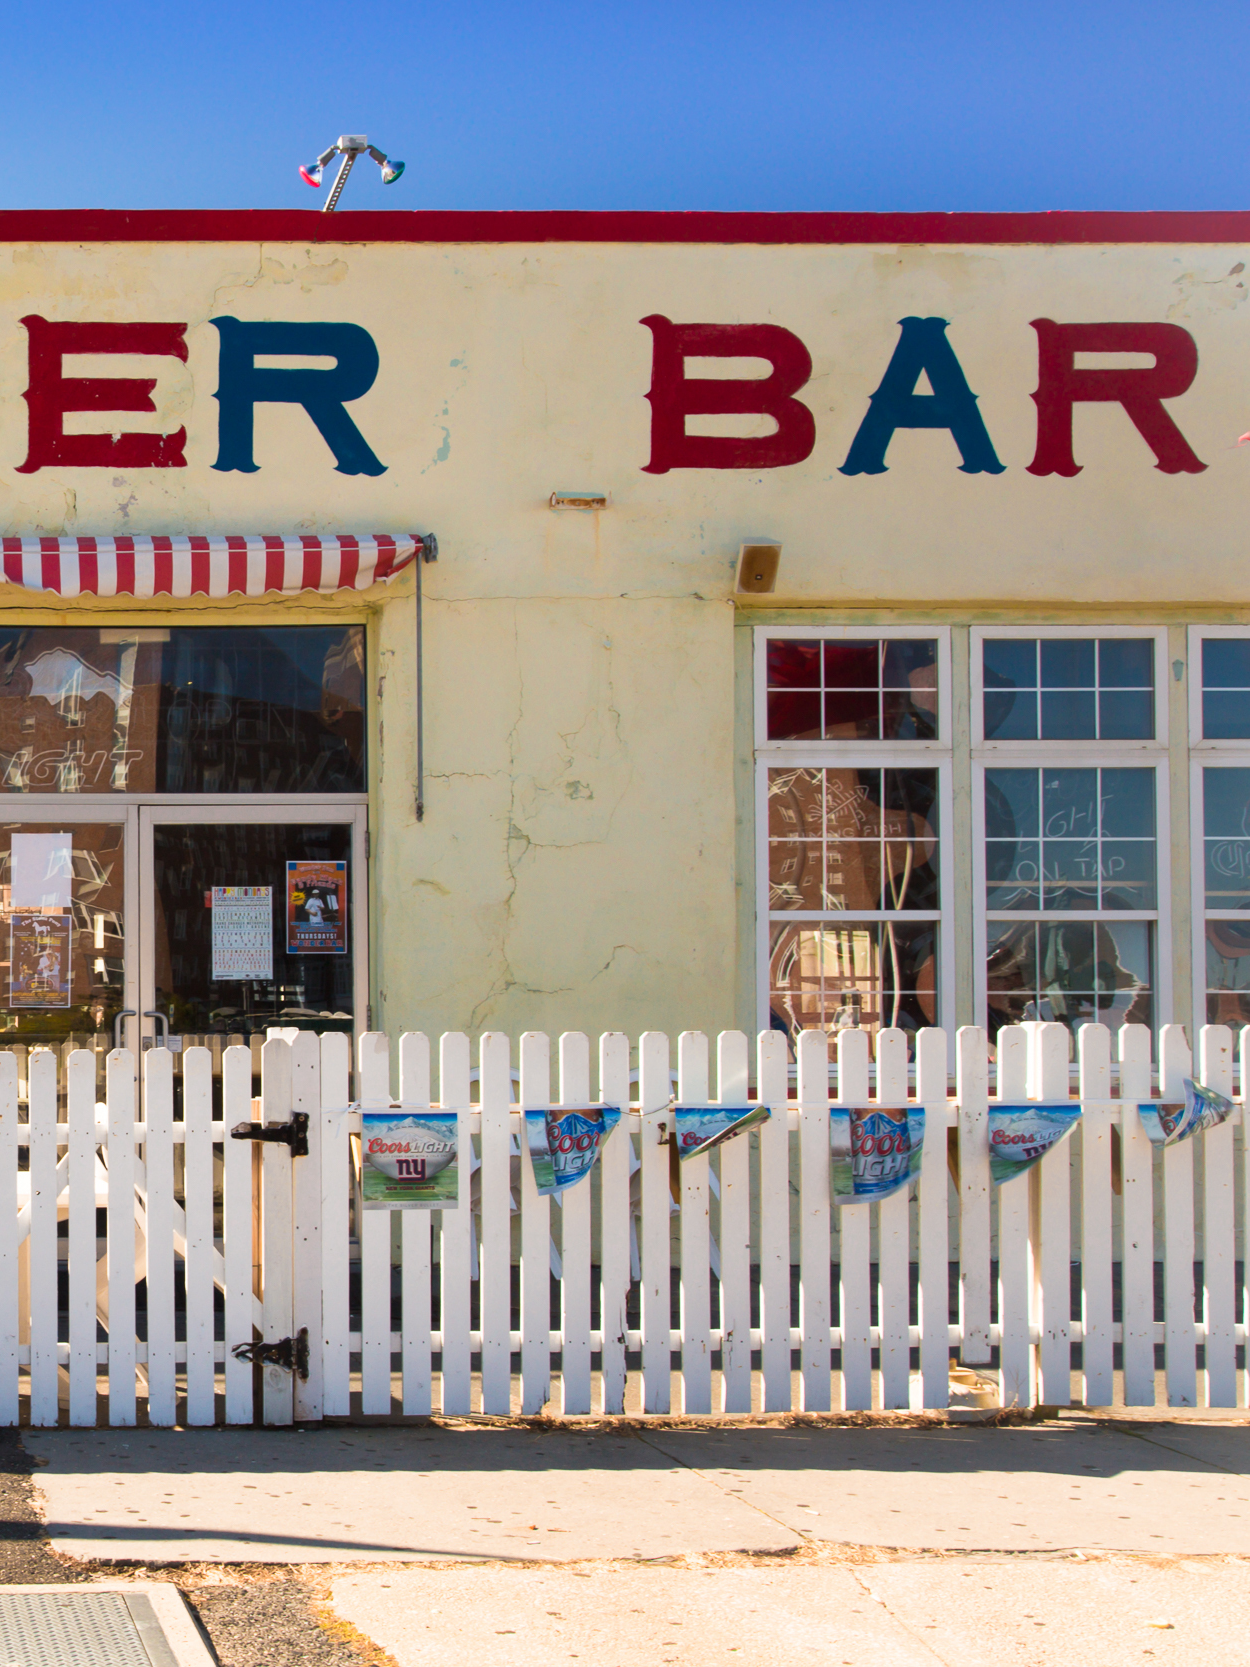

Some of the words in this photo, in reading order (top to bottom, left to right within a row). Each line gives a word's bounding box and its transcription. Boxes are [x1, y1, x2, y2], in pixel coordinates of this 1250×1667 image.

[639, 314, 1209, 477] BAR
[1018, 794, 1115, 853] LGHT
[1074, 856, 1125, 877] TAP
[214, 888, 235, 897] HAPPY
[368, 1137, 411, 1154] Coors
[410, 1141, 455, 1153] LIGHT
[546, 1124, 600, 1155] Coor
[991, 1129, 1037, 1145] Coors
